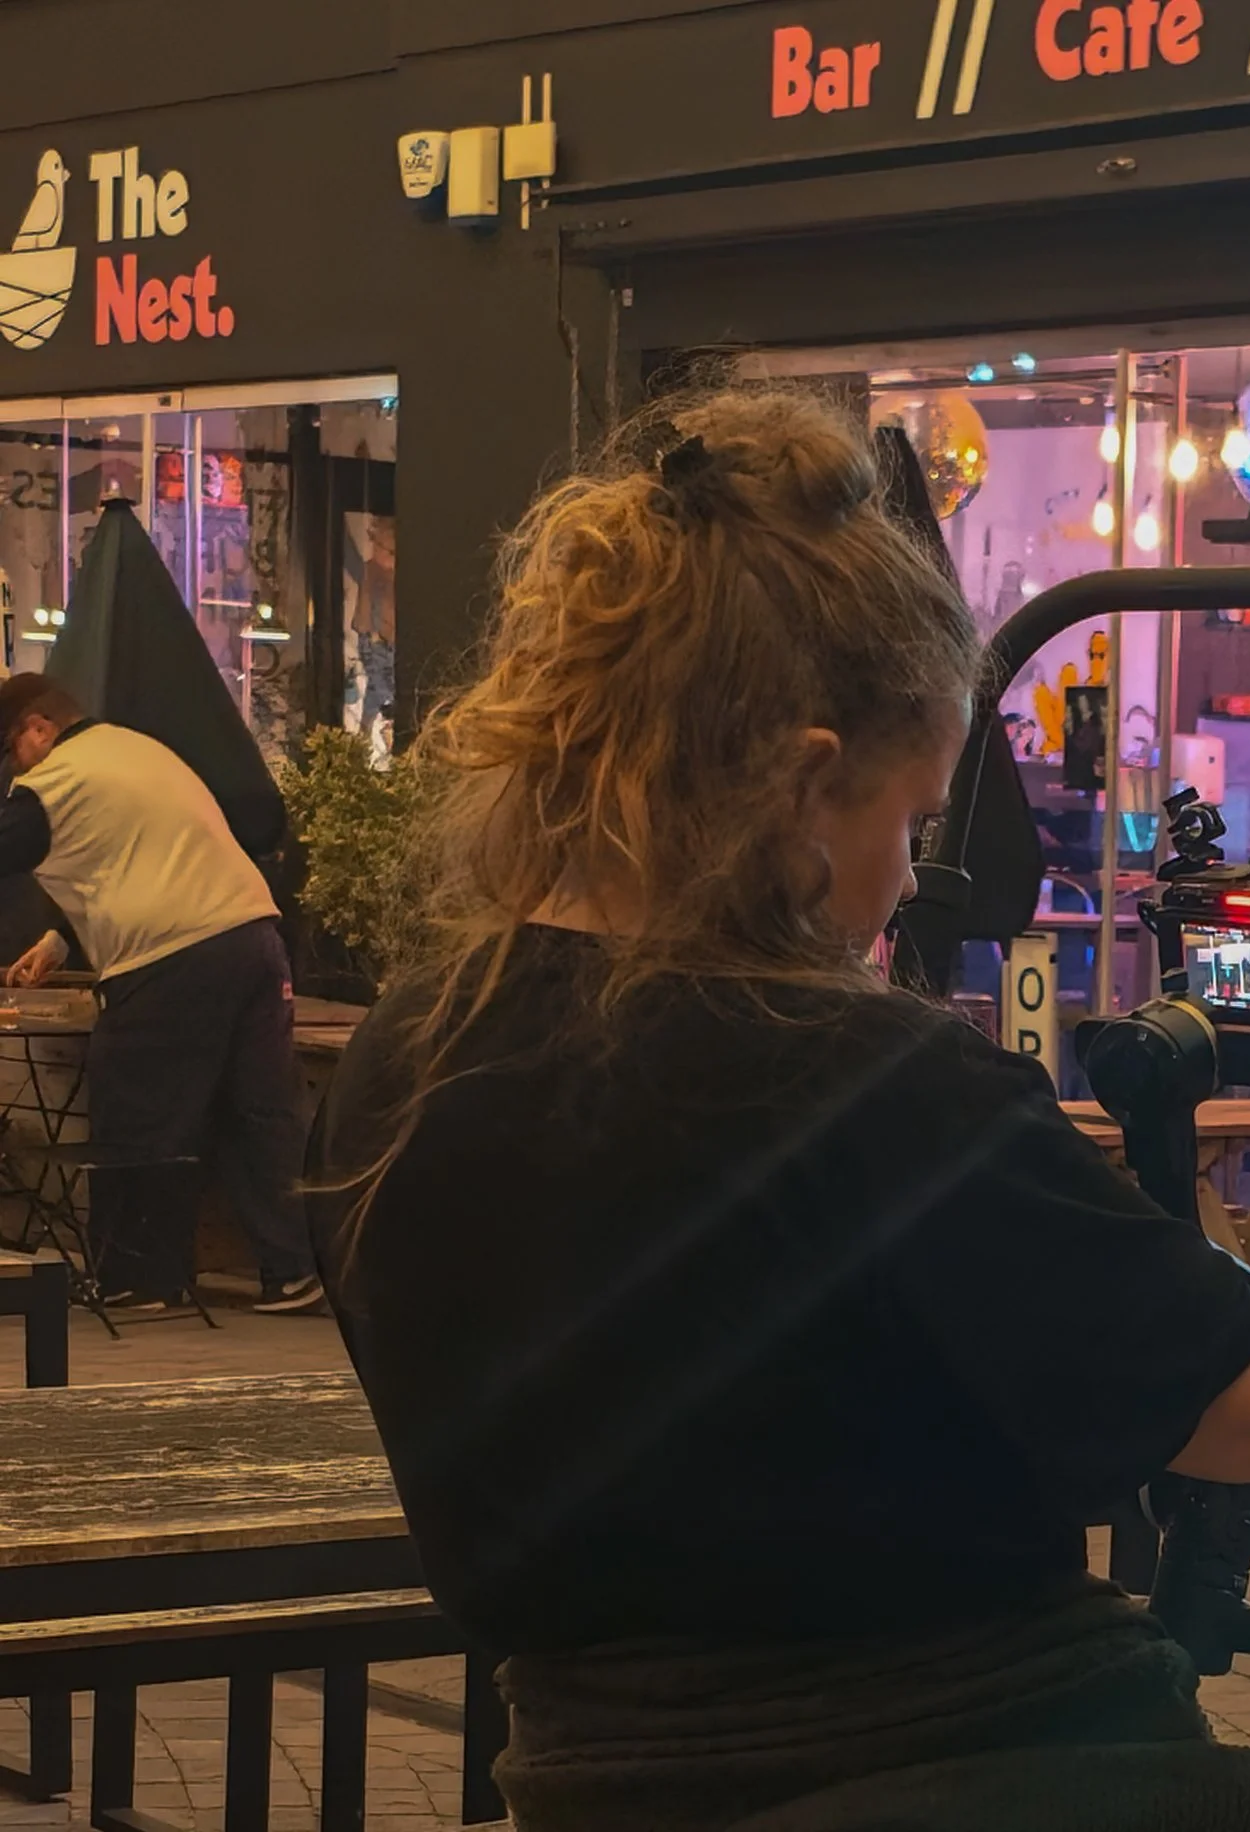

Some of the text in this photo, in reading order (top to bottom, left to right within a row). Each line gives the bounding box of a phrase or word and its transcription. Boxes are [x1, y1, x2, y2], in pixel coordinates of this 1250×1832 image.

[772, 26, 881, 118] Bar
[1035, 0, 1203, 81] Cafe
[89, 146, 190, 242] The
[95, 254, 236, 346] Nest.
